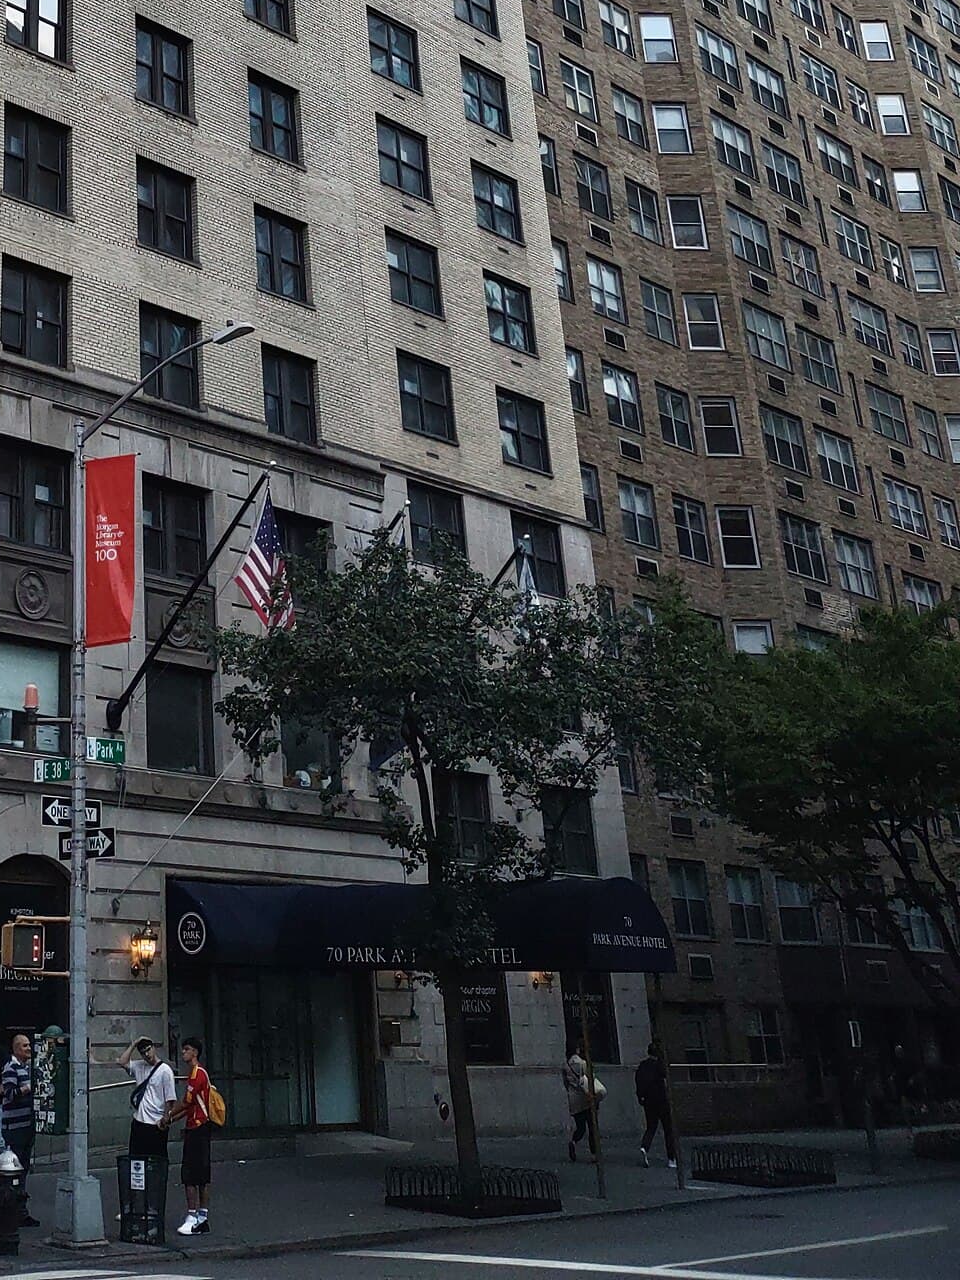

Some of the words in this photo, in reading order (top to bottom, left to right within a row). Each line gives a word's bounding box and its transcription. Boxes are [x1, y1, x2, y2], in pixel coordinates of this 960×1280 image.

[95, 548, 117, 562] 100
[96, 742, 114, 759] Park
[44, 762, 49, 779] E
[51, 762, 62, 778] 38
[64, 760, 71, 770] St
[50, 806, 68, 818] ONE
[88, 837, 106, 849] WAY
[186, 921, 197, 930] 70
[624, 916, 632, 927] 70
[183, 930, 201, 939] PARK
[592, 932, 611, 945] PARK
[613, 934, 641, 947] AVENUE
[642, 936, 668, 949] HOTEL
[326, 947, 342, 962] 70
[347, 947, 386, 963] PARK
